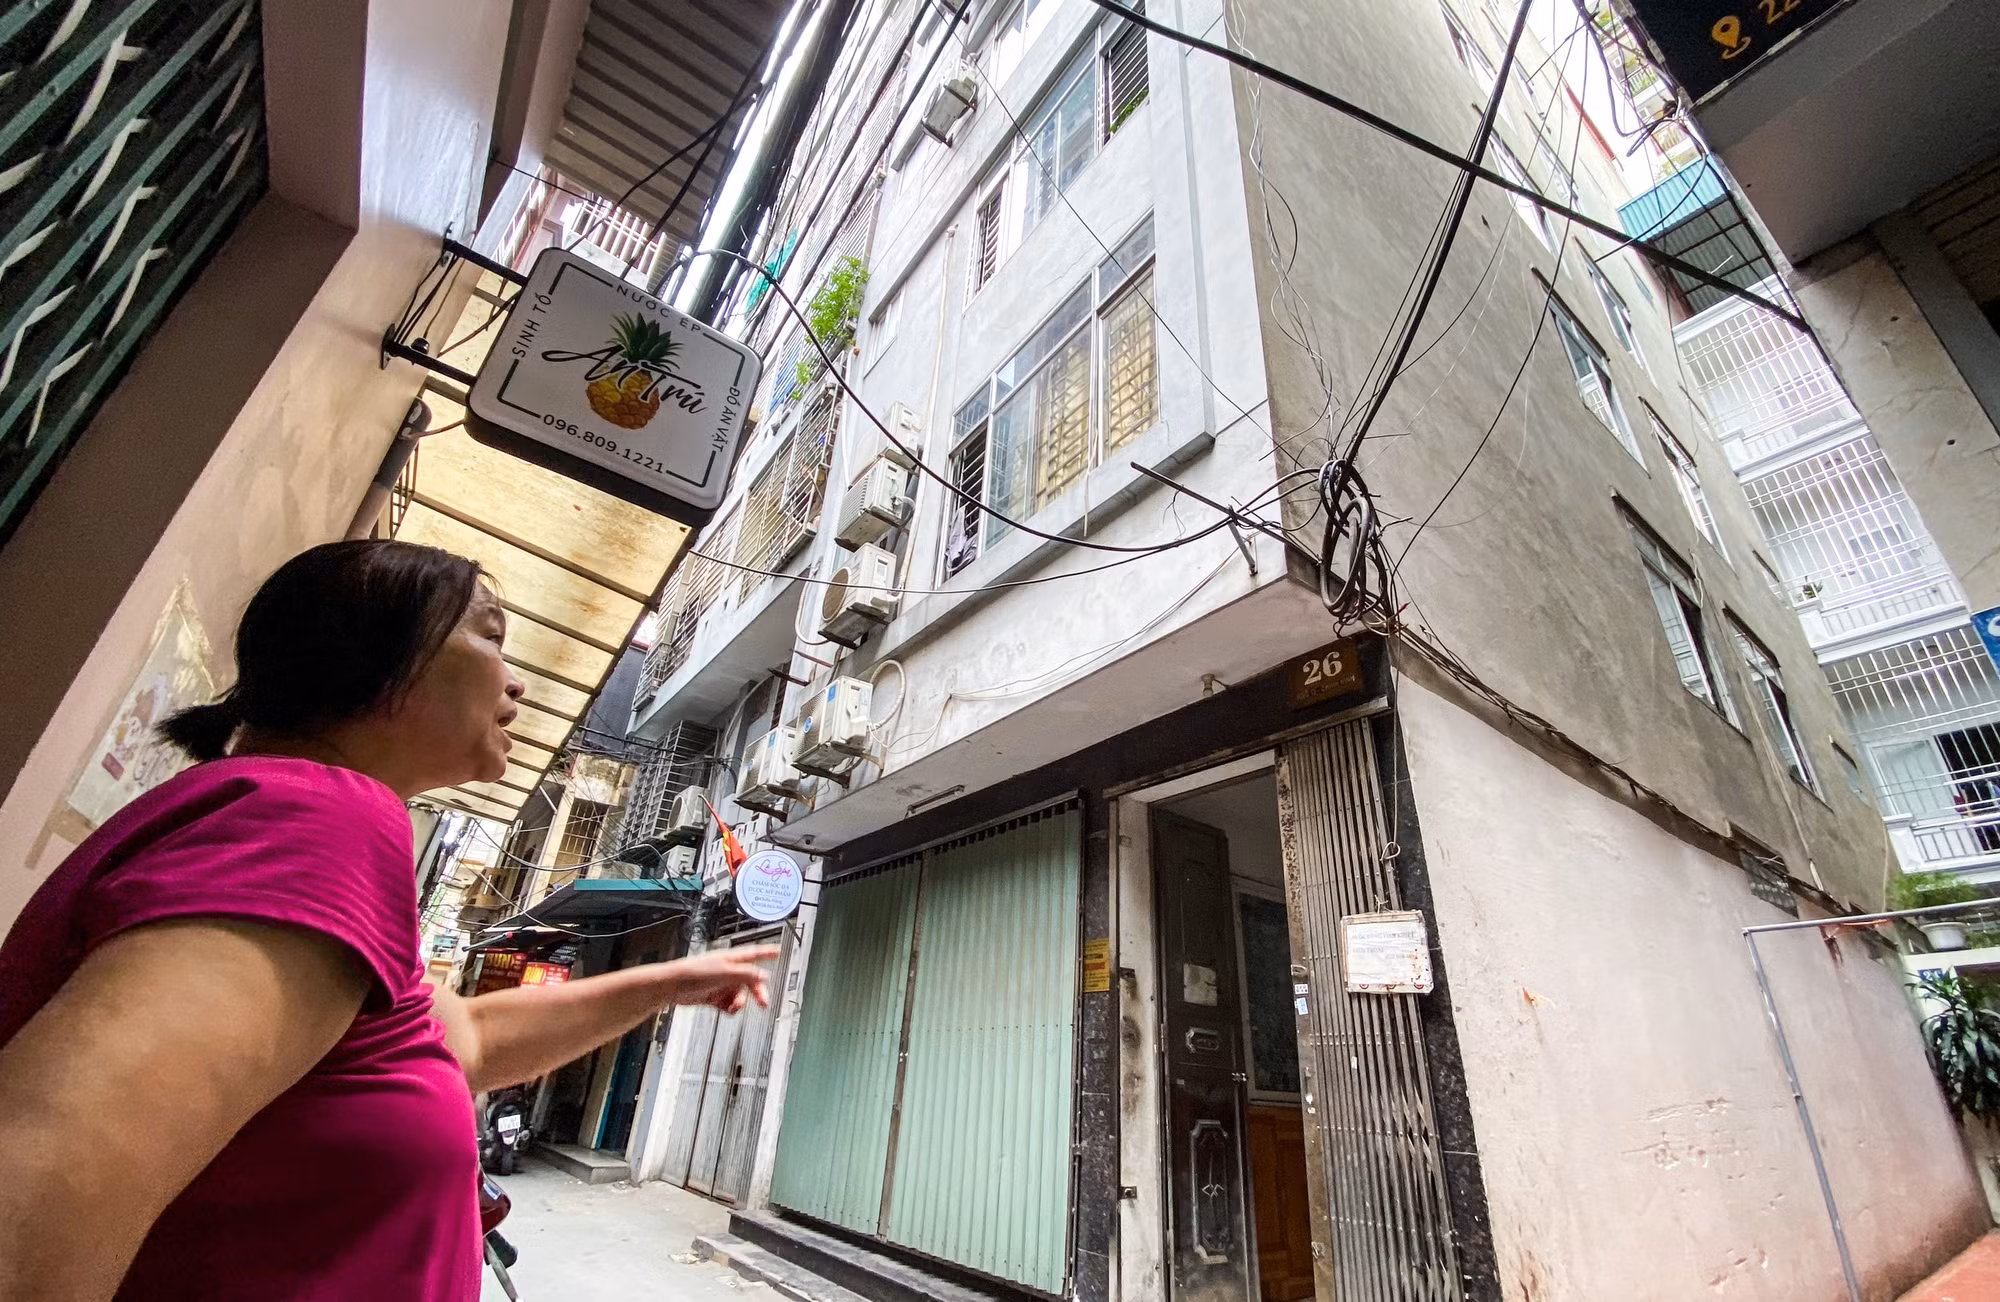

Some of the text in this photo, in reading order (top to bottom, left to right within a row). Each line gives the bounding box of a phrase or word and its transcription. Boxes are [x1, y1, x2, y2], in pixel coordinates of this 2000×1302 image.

[512, 292, 552, 358] SINH TỐ
[679, 317, 702, 332] ÉP
[719, 405, 736, 426] ĂN
[542, 414, 664, 474] 096.809.1221
[1302, 651, 1343, 686] 26
